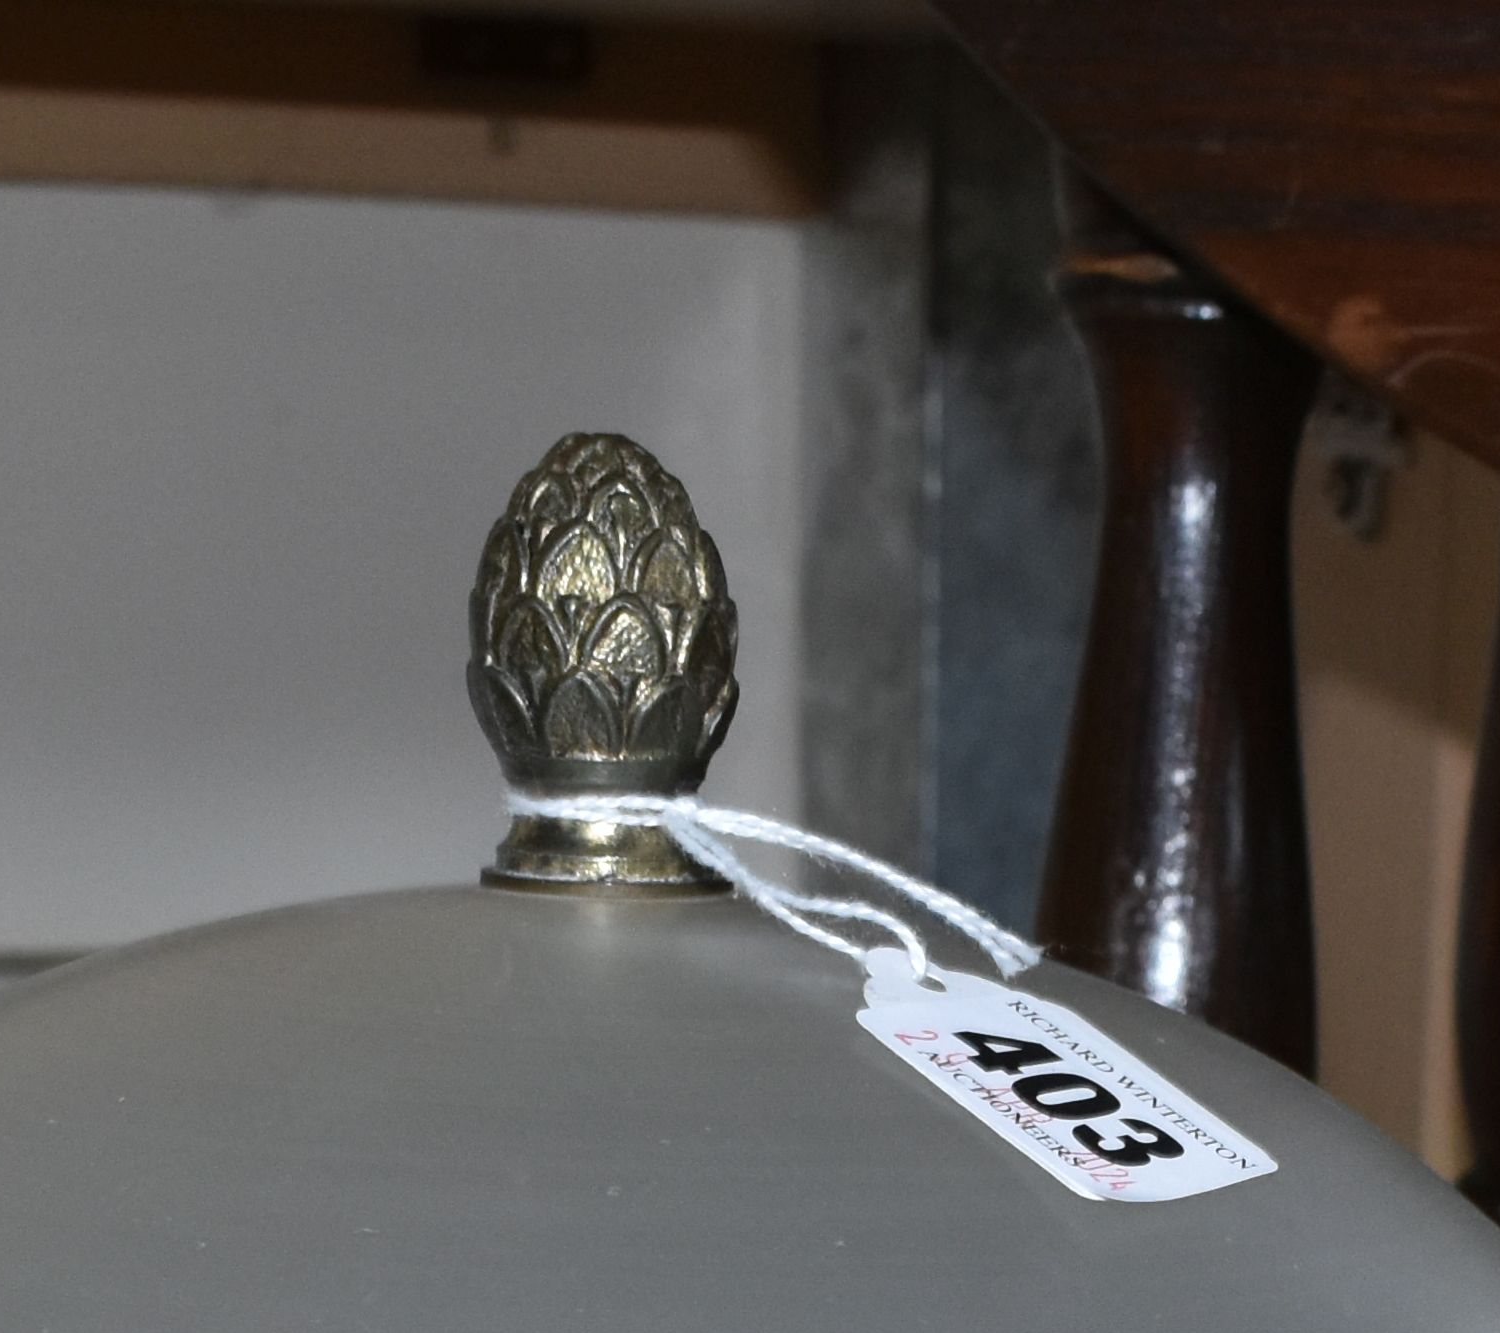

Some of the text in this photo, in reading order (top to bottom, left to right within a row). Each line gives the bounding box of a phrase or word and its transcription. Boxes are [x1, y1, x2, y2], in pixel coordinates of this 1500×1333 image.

[917, 1049, 1086, 1168] AUCTIONEERS
[951, 1030, 1186, 1168] 403
[1007, 999, 1257, 1172] RICHARD WINTERTON
